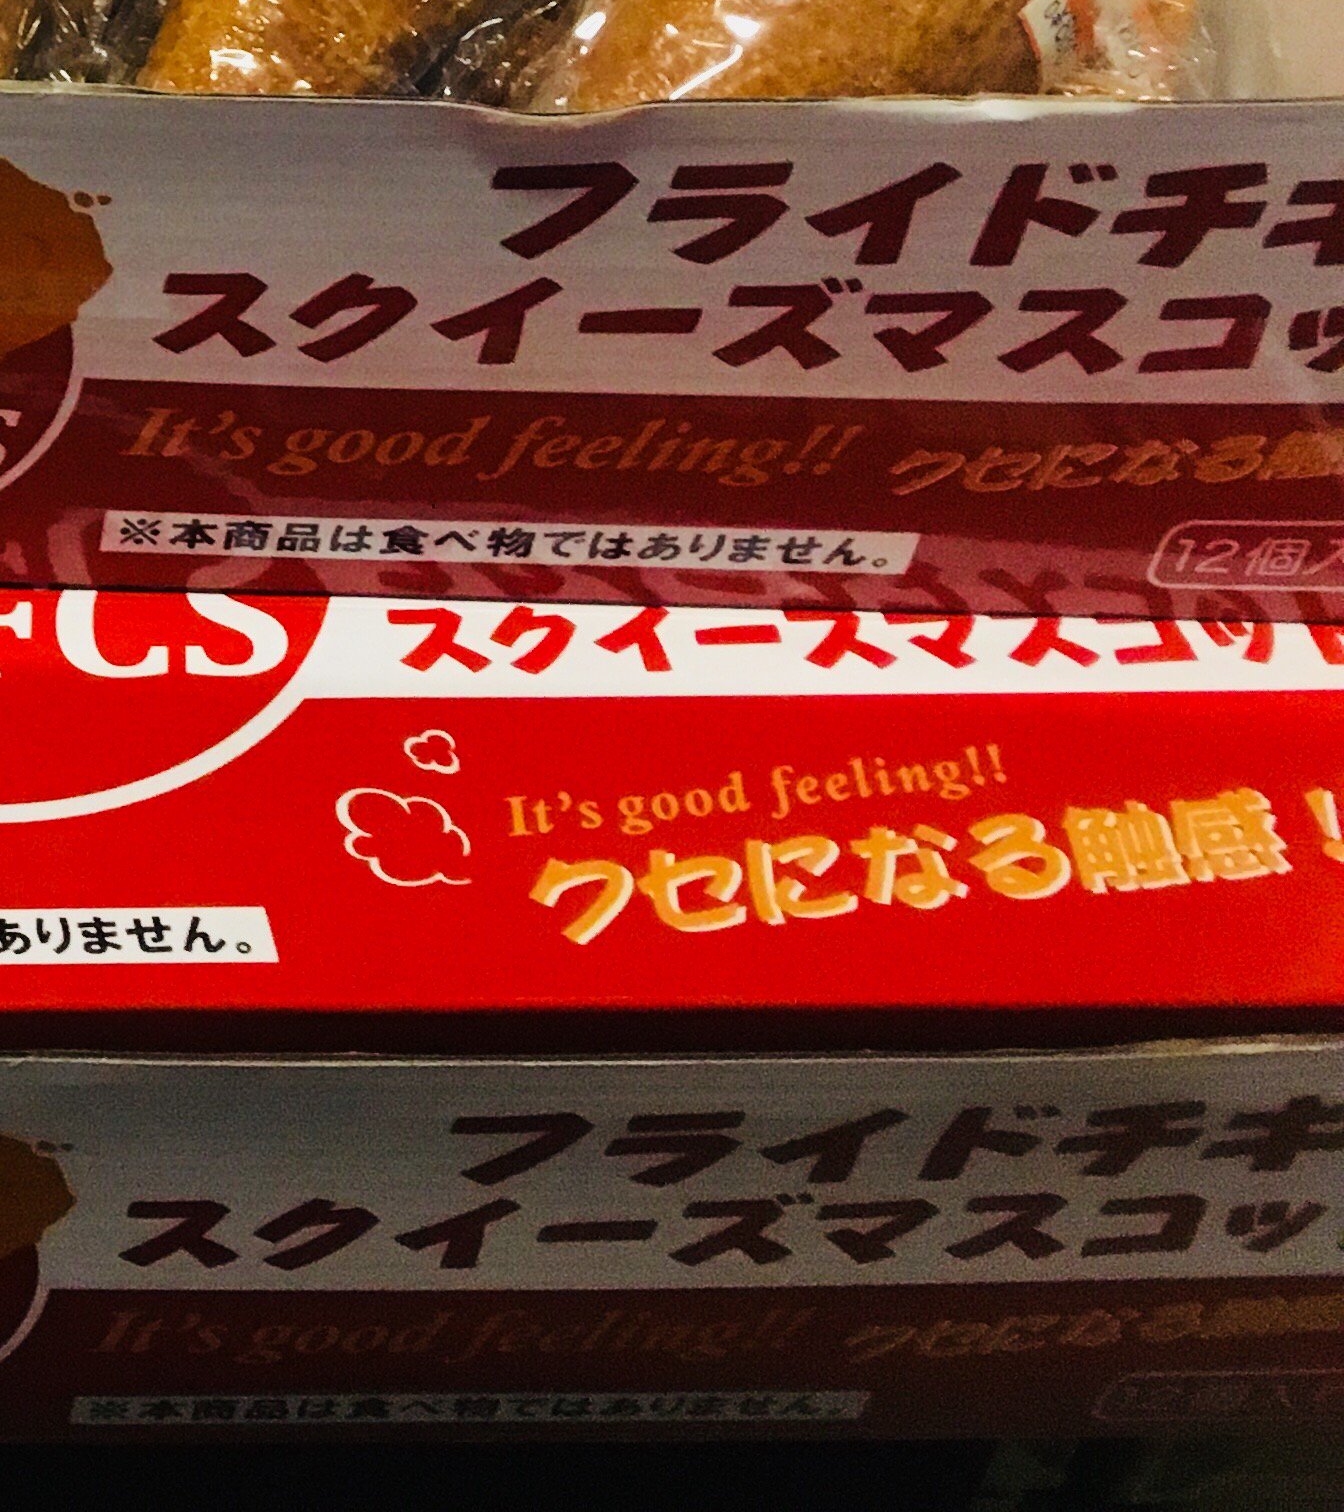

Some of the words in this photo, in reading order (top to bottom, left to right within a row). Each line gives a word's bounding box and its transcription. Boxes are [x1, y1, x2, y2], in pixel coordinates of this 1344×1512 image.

[490, 160, 1344, 267] フライドチキ
[152, 272, 1344, 376] スクイーズマスコッ
[119, 407, 263, 462] It's
[273, 407, 475, 475] good
[480, 417, 866, 483] feeling!!
[118, 516, 891, 573] ※本商品は食べ物ではありません。
[505, 788, 604, 838] It's
[617, 767, 749, 838] good
[771, 743, 1008, 813] feeling!!
[448, 1094, 1344, 1186] フライドチキ
[118, 1193, 1344, 1271] スクイーズマスコッ
[237, 1308, 446, 1364] good
